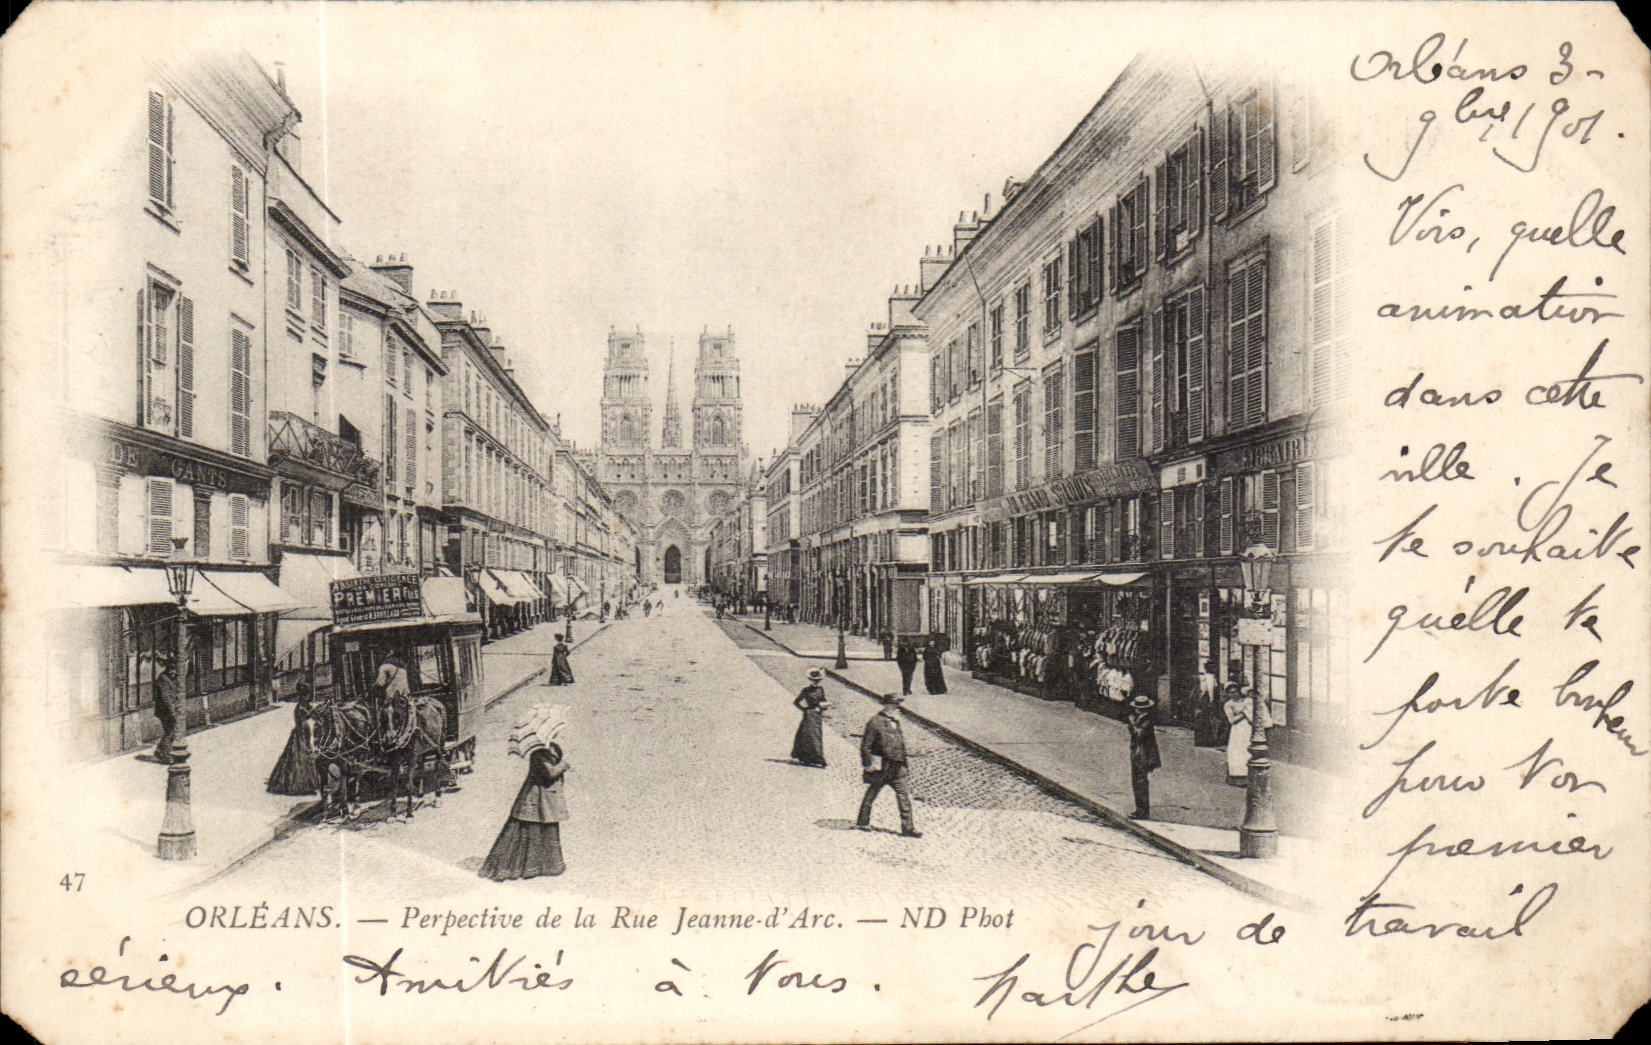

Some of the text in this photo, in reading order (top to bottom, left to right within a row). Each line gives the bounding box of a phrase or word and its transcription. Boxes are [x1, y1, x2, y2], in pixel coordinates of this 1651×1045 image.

[1350, 32, 1528, 84] Orléans
[1489, 188, 1626, 282] quelle
[1377, 275, 1625, 325] animation
[1384, 338, 1644, 410] dans cette
[171, 460, 228, 488] GANTS
[1517, 435, 1618, 532] Je
[1373, 504, 1641, 570] te souhaite
[333, 586, 401, 607] PREMIER
[1360, 658, 1522, 750] porte
[1362, 740, 1486, 819] pour
[1360, 813, 1614, 902] premier
[1066, 883, 1559, 989] jour de travail
[654, 958, 691, 997] à
